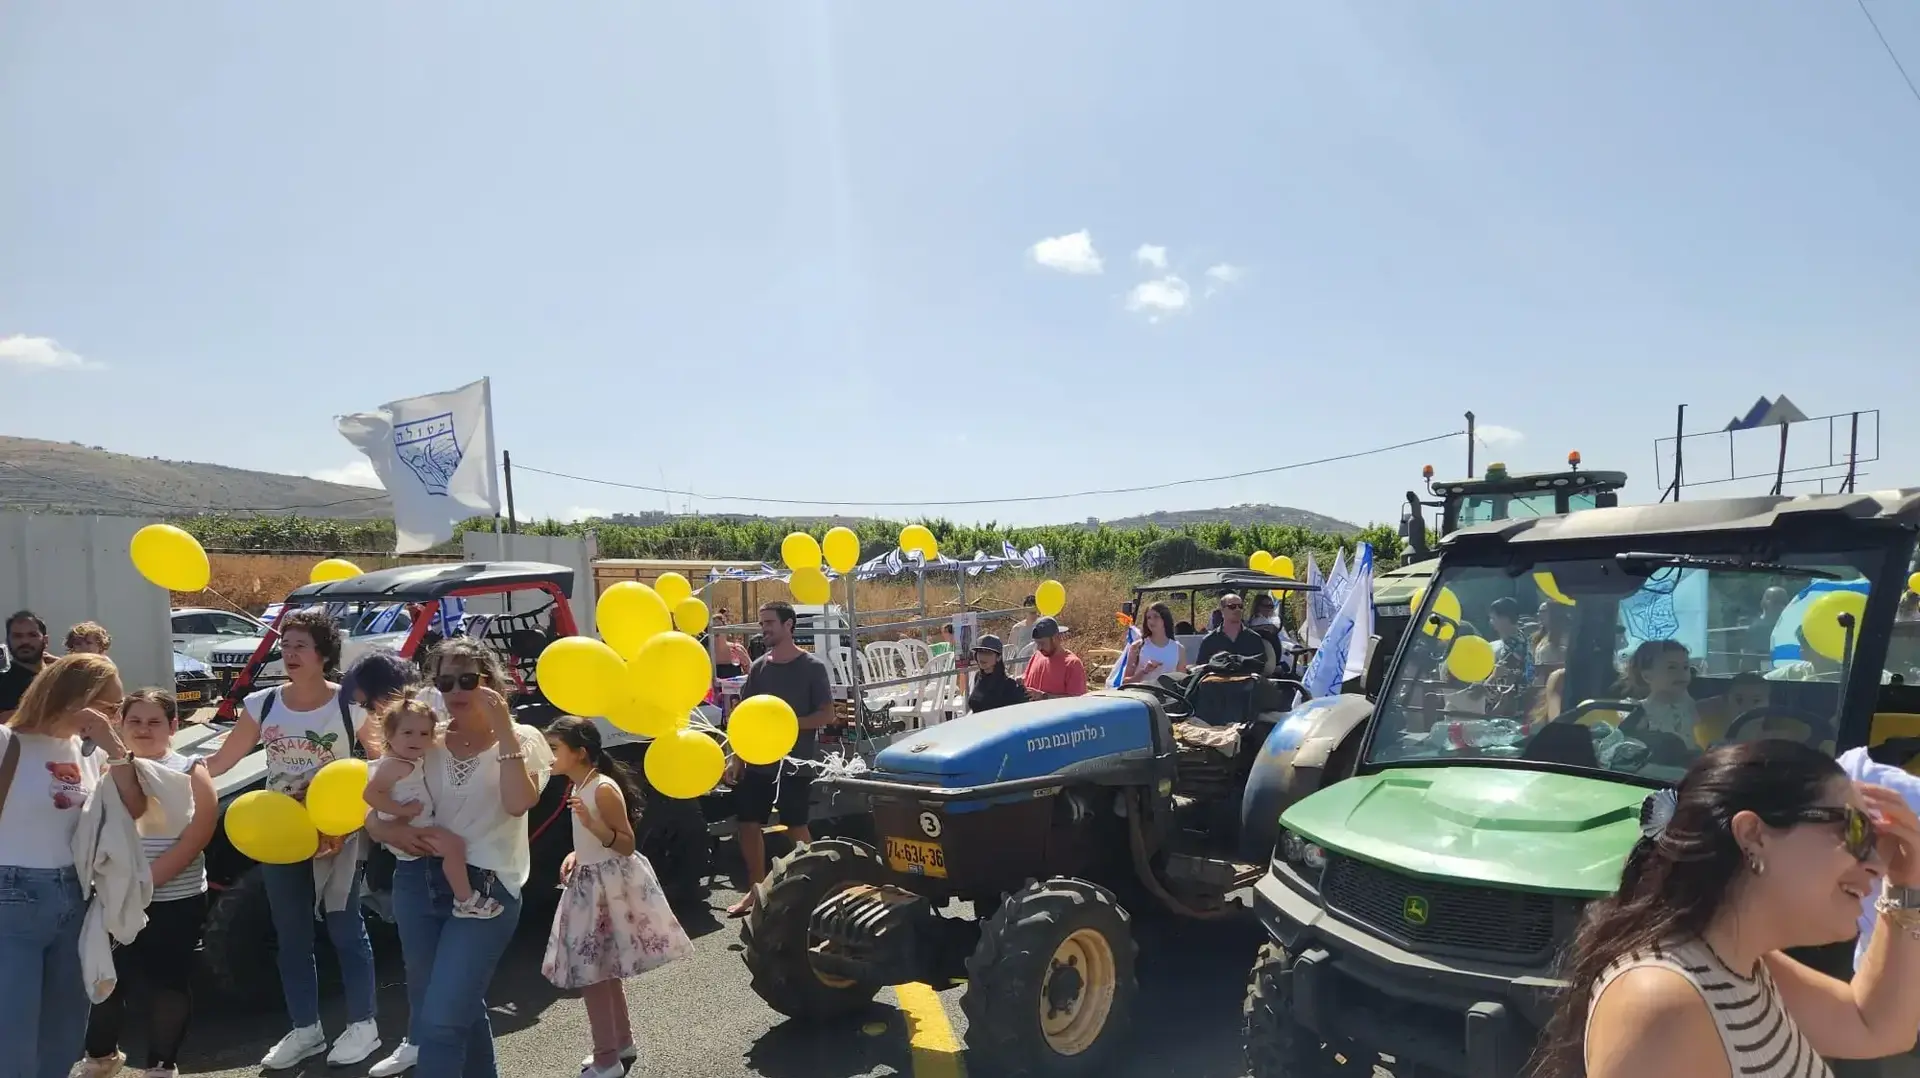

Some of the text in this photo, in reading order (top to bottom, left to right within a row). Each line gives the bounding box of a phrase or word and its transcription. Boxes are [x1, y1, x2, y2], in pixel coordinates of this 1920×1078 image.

[1071, 724, 1098, 748] פלדמן
[282, 755, 314, 768] CUBA
[924, 816, 937, 832] 3
